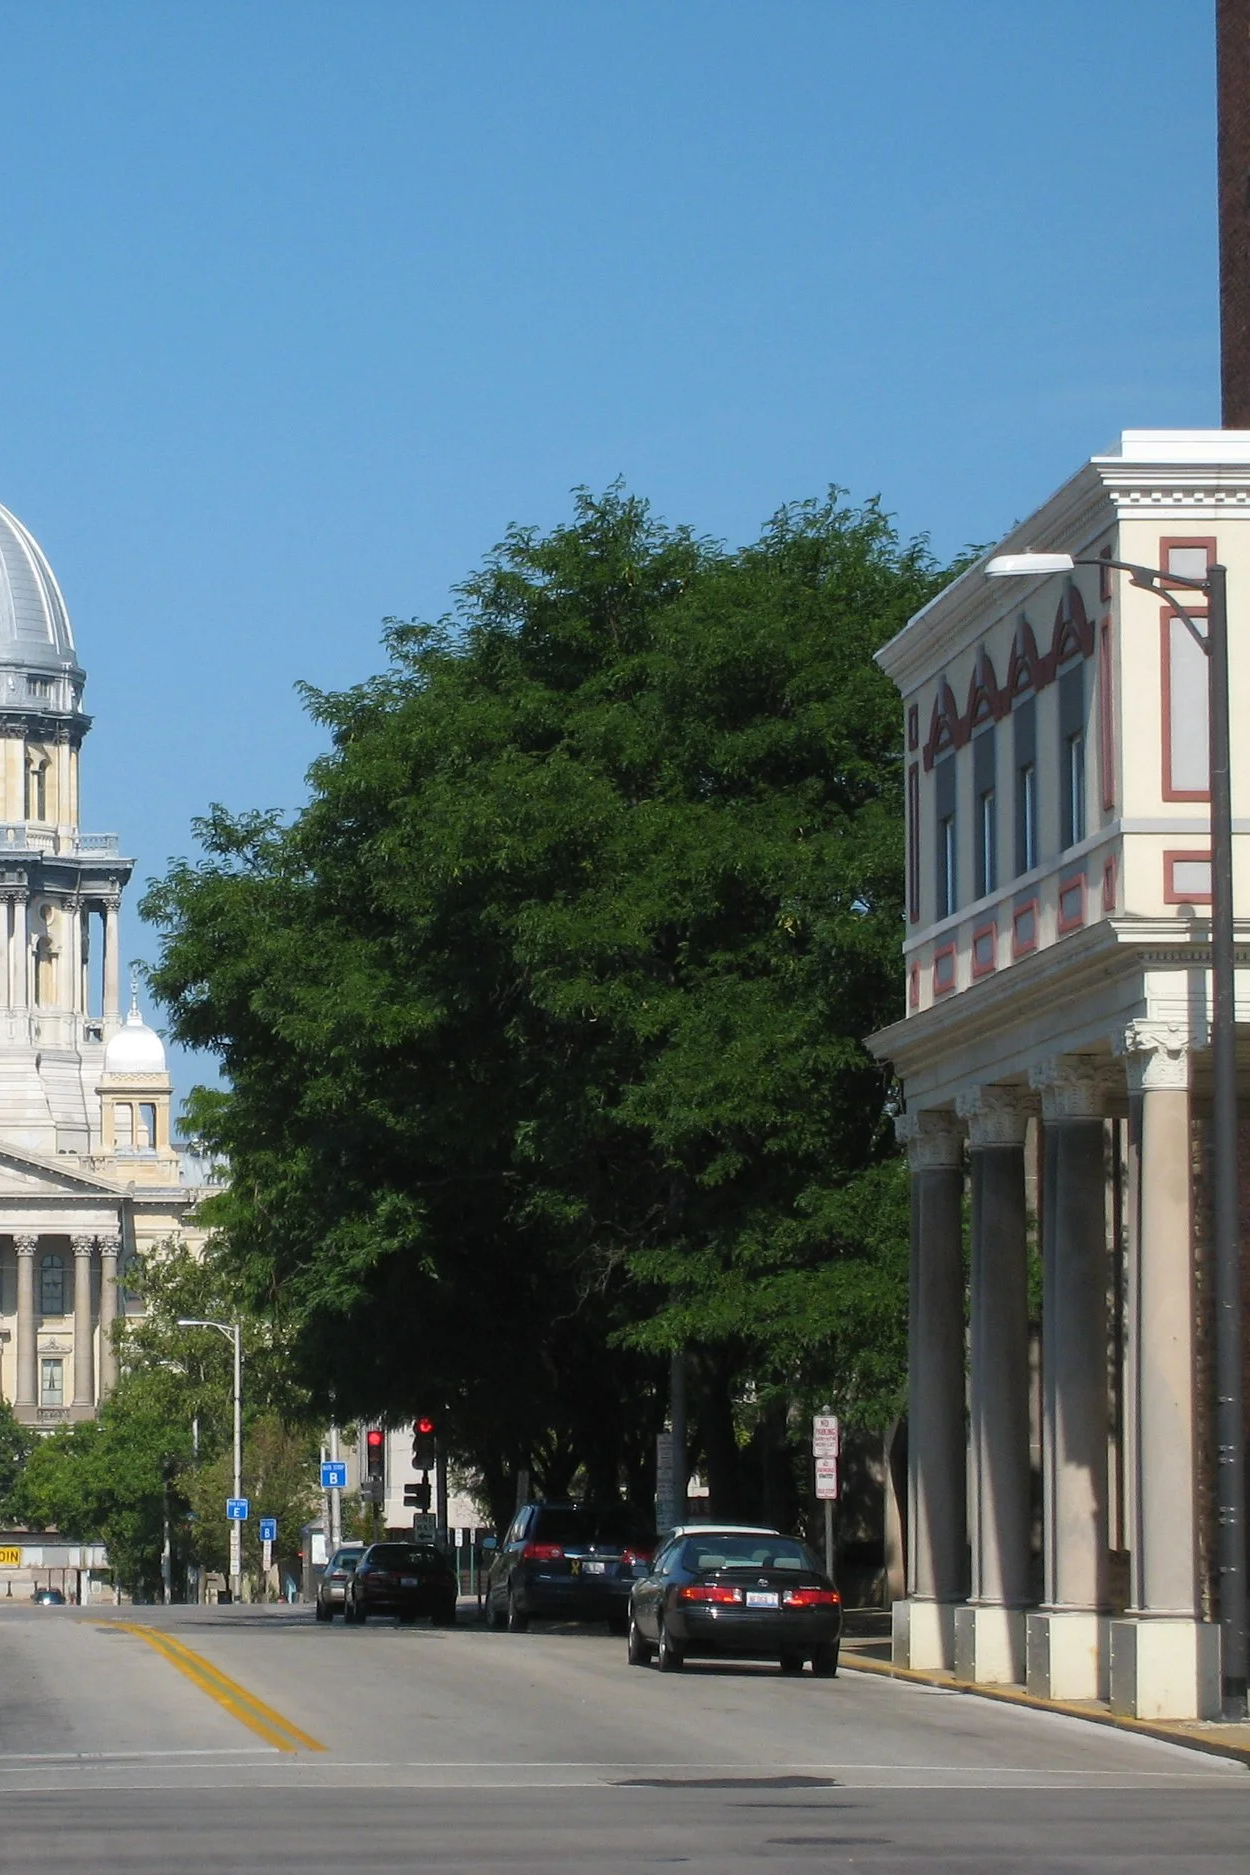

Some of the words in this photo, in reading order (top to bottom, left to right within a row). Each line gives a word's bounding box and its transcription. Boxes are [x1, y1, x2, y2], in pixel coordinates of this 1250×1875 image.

[329, 1472, 338, 1485] B
[233, 1507, 241, 1517] E
[264, 1527, 271, 1538] B
